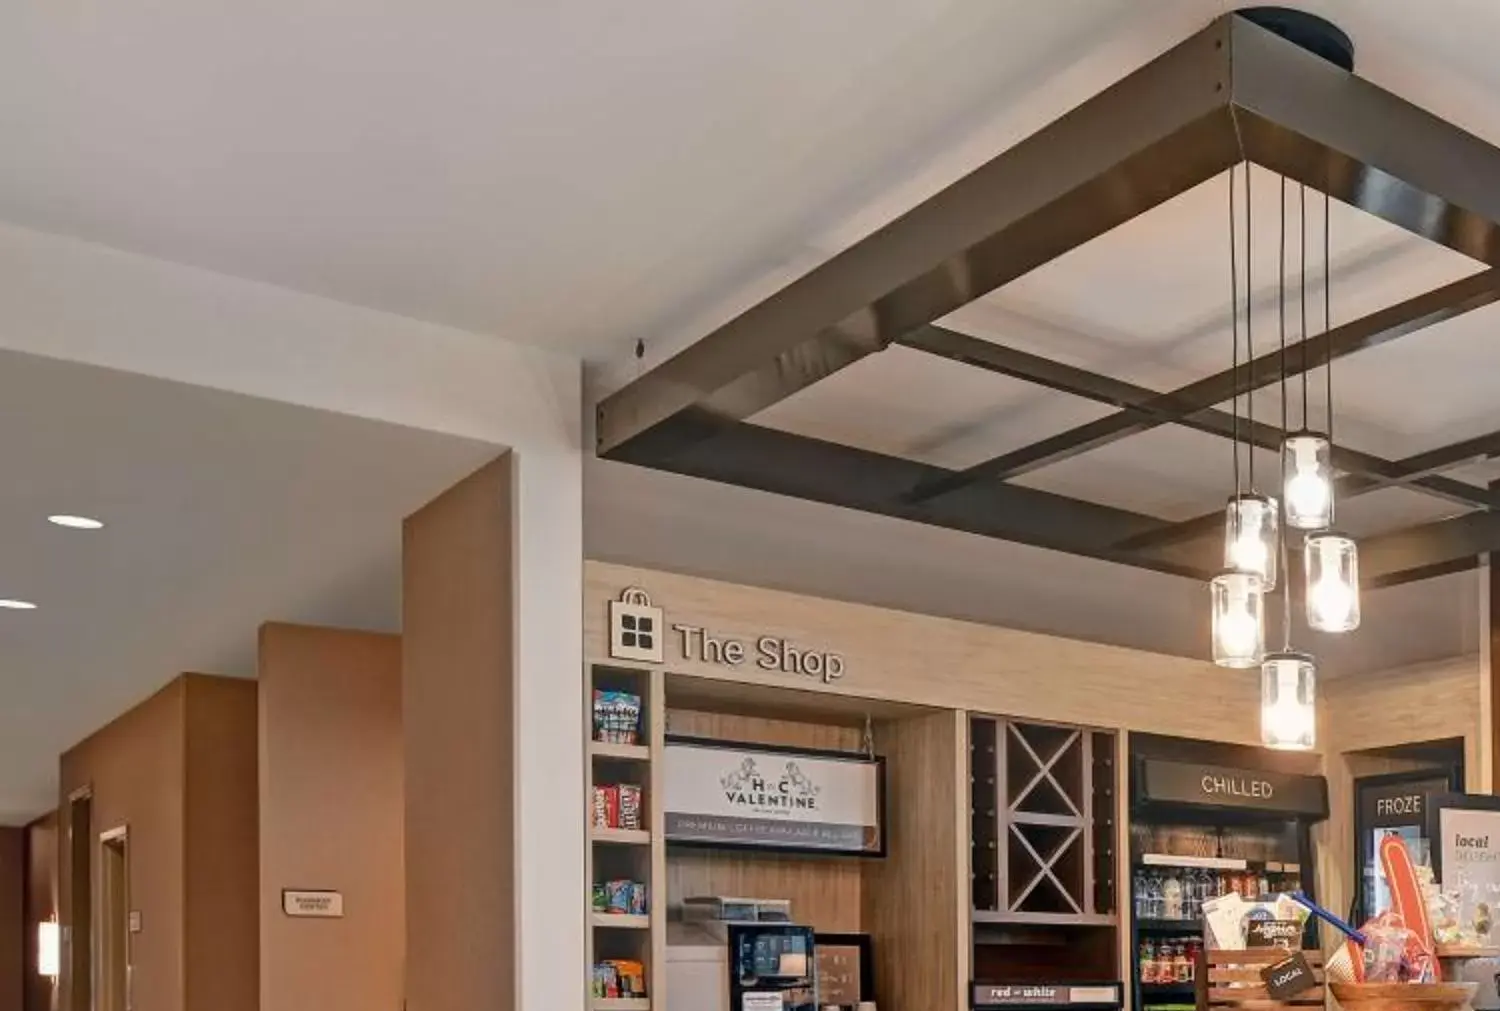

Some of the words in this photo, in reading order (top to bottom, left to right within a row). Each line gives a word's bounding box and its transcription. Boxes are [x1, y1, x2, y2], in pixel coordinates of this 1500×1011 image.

[672, 624, 744, 665] The
[757, 637, 845, 683] Shop
[752, 778, 765, 791] H
[777, 780, 789, 794] C
[1201, 775, 1273, 799] CHILLED
[725, 791, 815, 809] VALENTINE
[1376, 795, 1421, 817] FROZE
[1455, 833, 1489, 849] local
[1273, 967, 1304, 987] LOCAL
